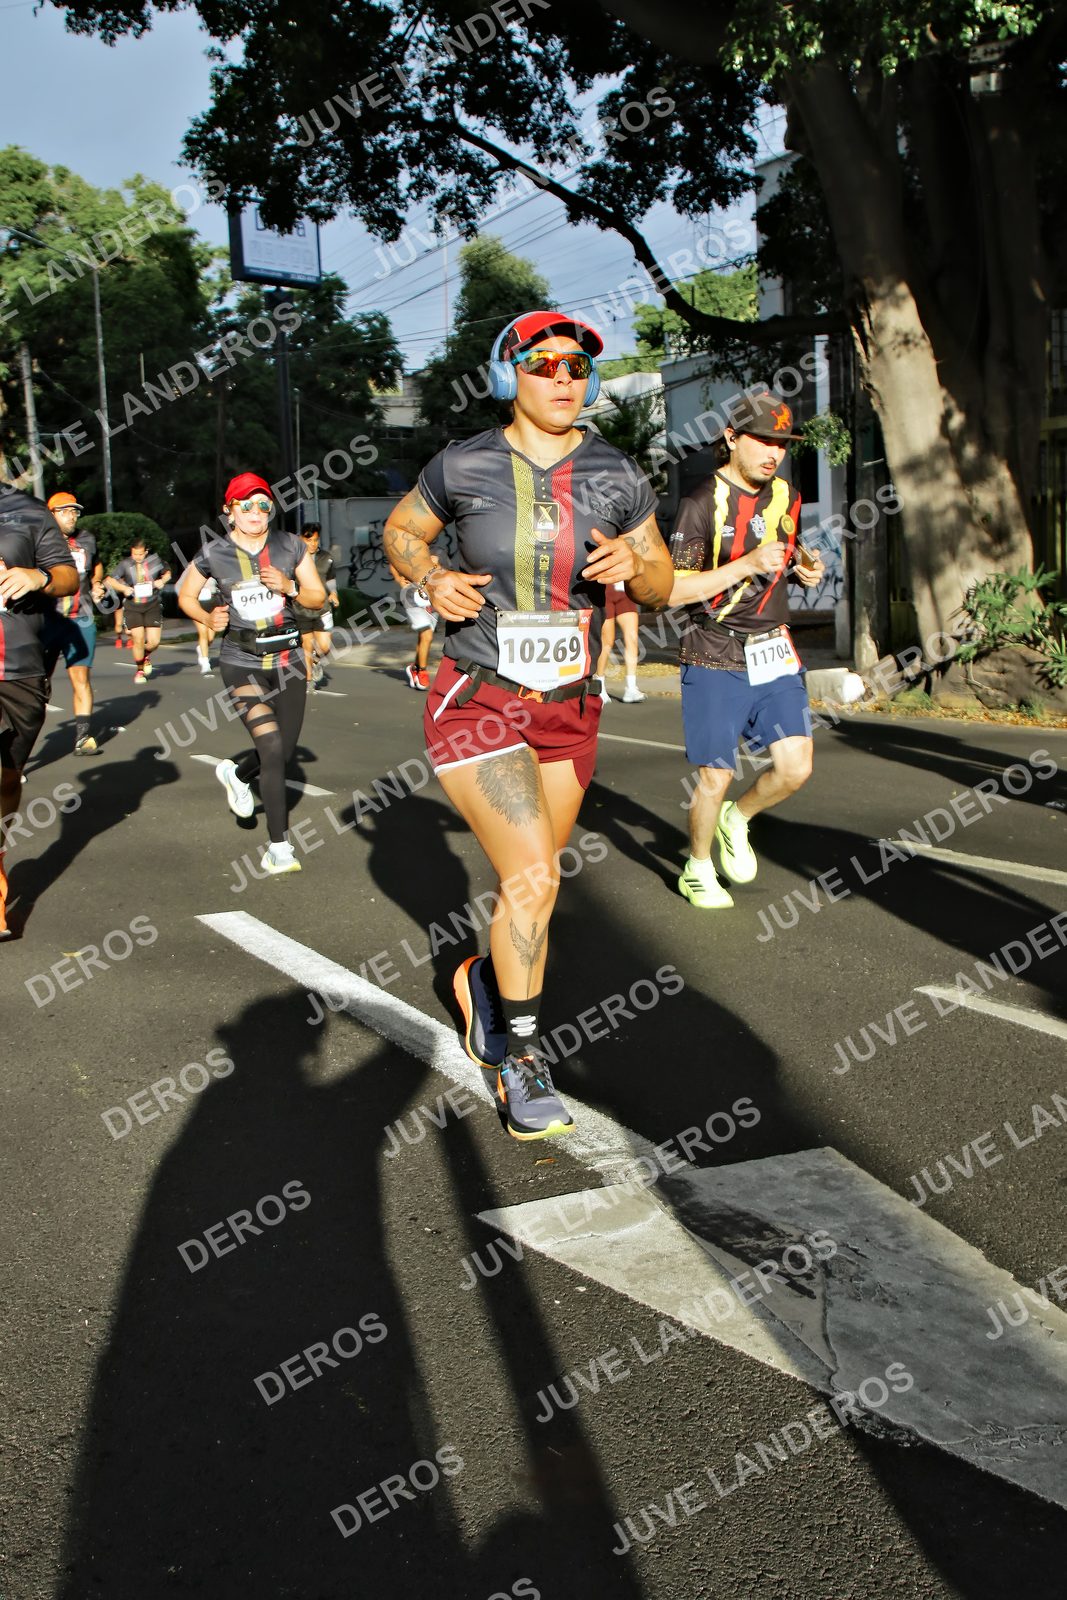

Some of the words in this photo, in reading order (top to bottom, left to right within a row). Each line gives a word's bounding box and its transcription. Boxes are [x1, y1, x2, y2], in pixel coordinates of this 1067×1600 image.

[240, 590, 273, 607] 9610
[503, 635, 581, 664] 10269
[750, 642, 792, 667] 11704
